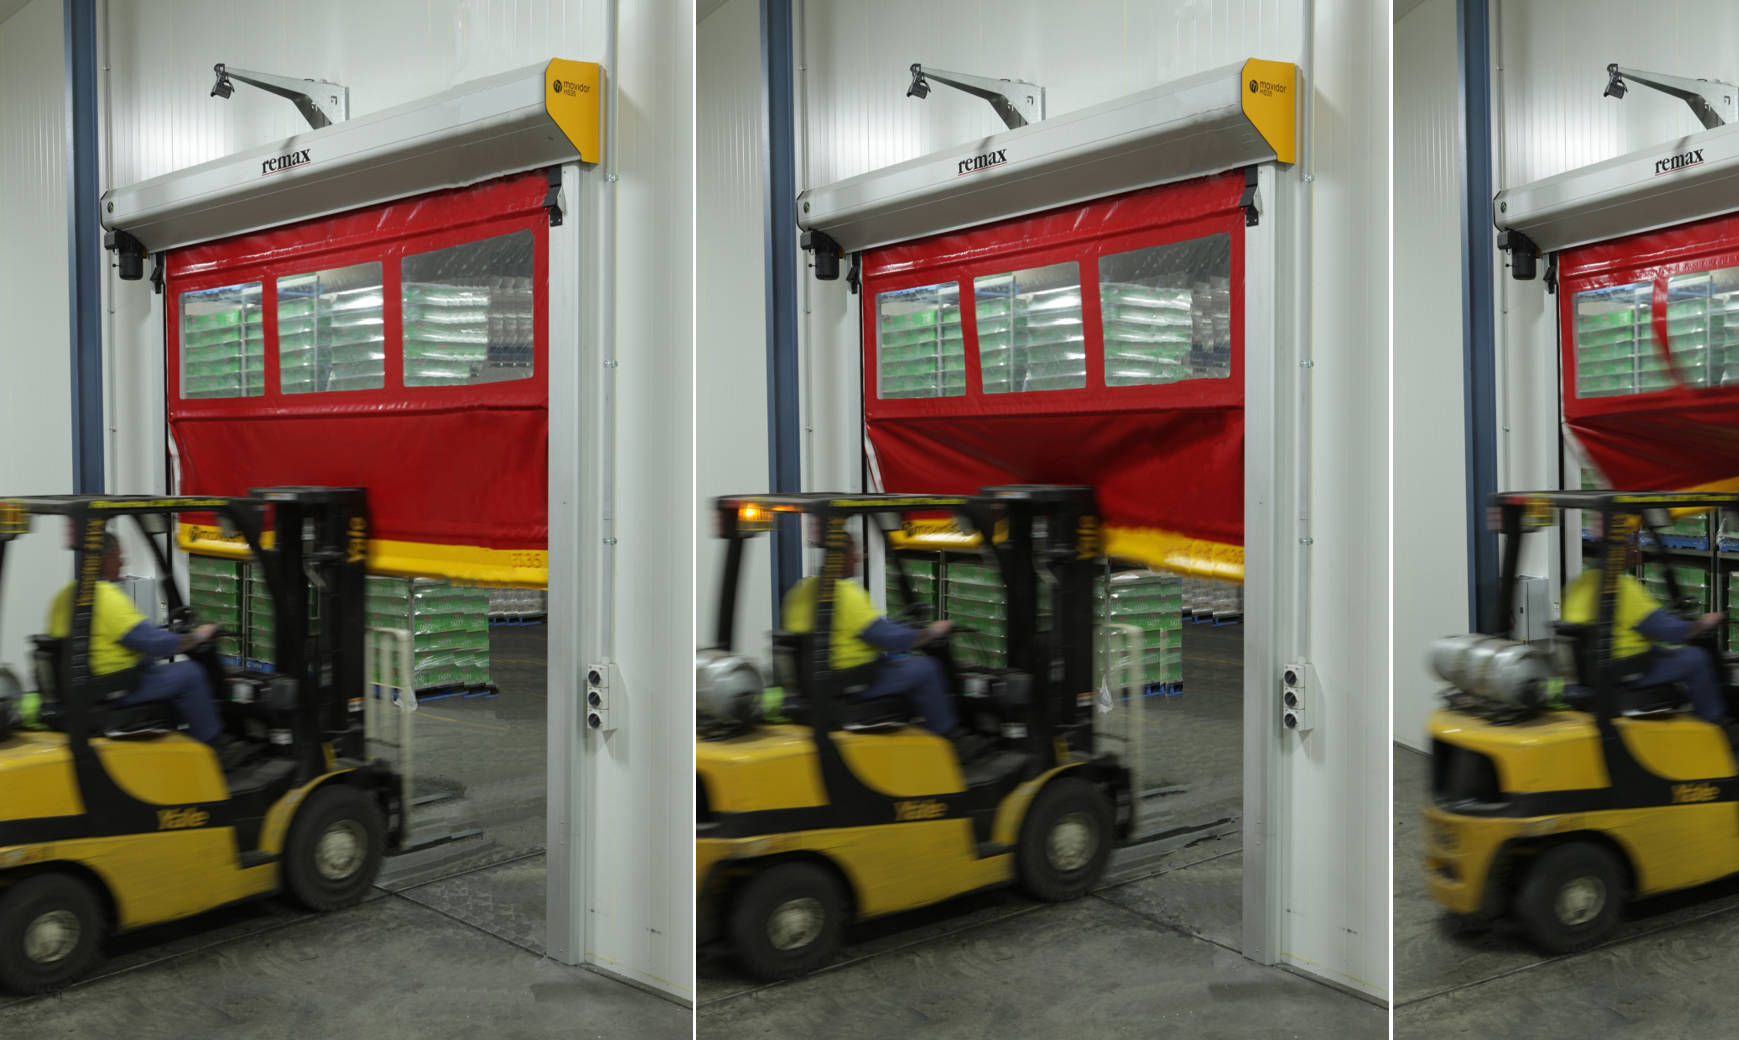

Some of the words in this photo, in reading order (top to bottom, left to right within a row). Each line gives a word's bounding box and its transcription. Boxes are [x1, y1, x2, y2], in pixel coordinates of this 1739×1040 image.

[261, 148, 311, 174] remax
[957, 148, 1007, 174] remax
[1654, 148, 1704, 174] remax
